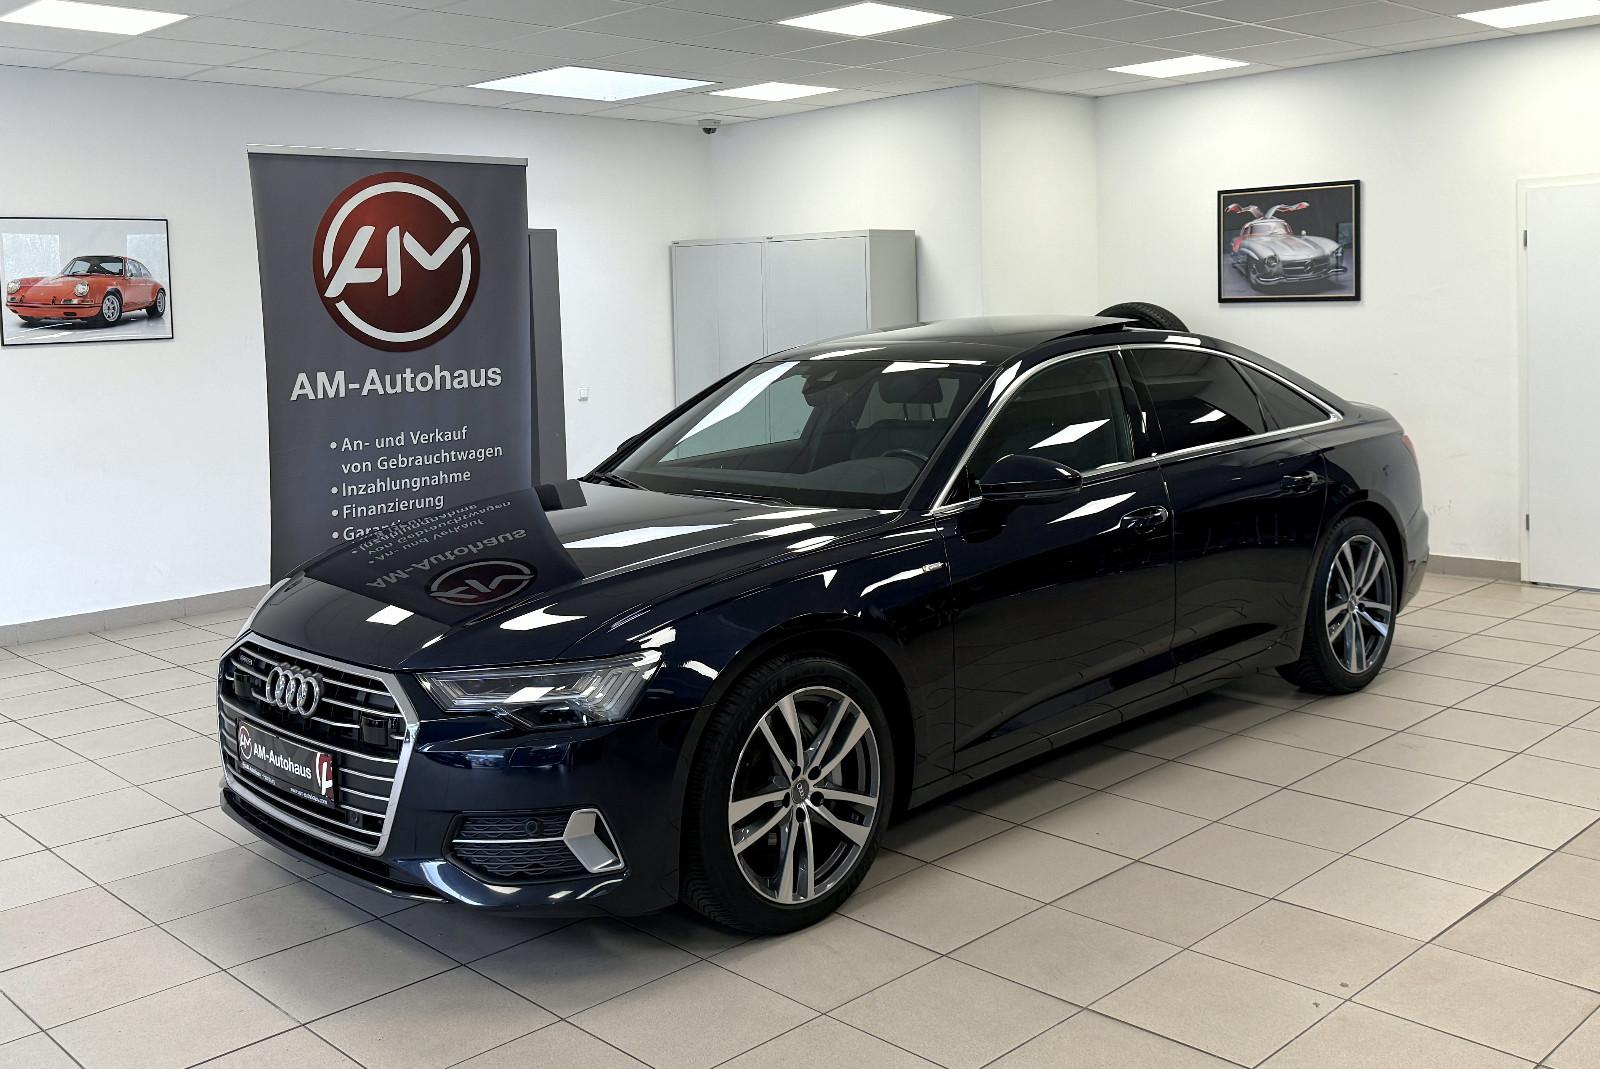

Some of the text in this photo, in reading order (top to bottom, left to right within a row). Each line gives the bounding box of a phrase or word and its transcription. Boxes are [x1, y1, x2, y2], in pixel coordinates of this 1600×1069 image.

[324, 225, 471, 298] AM
[290, 364, 502, 401] AM-Autohaus
[341, 425, 468, 452] An- und Verkauf
[341, 446, 503, 474] von Gebrauchtwagen
[342, 470, 472, 497] Inzahlungnahme
[342, 495, 445, 519] Finanzierung
[253, 742, 312, 779] AM-Autohaus
